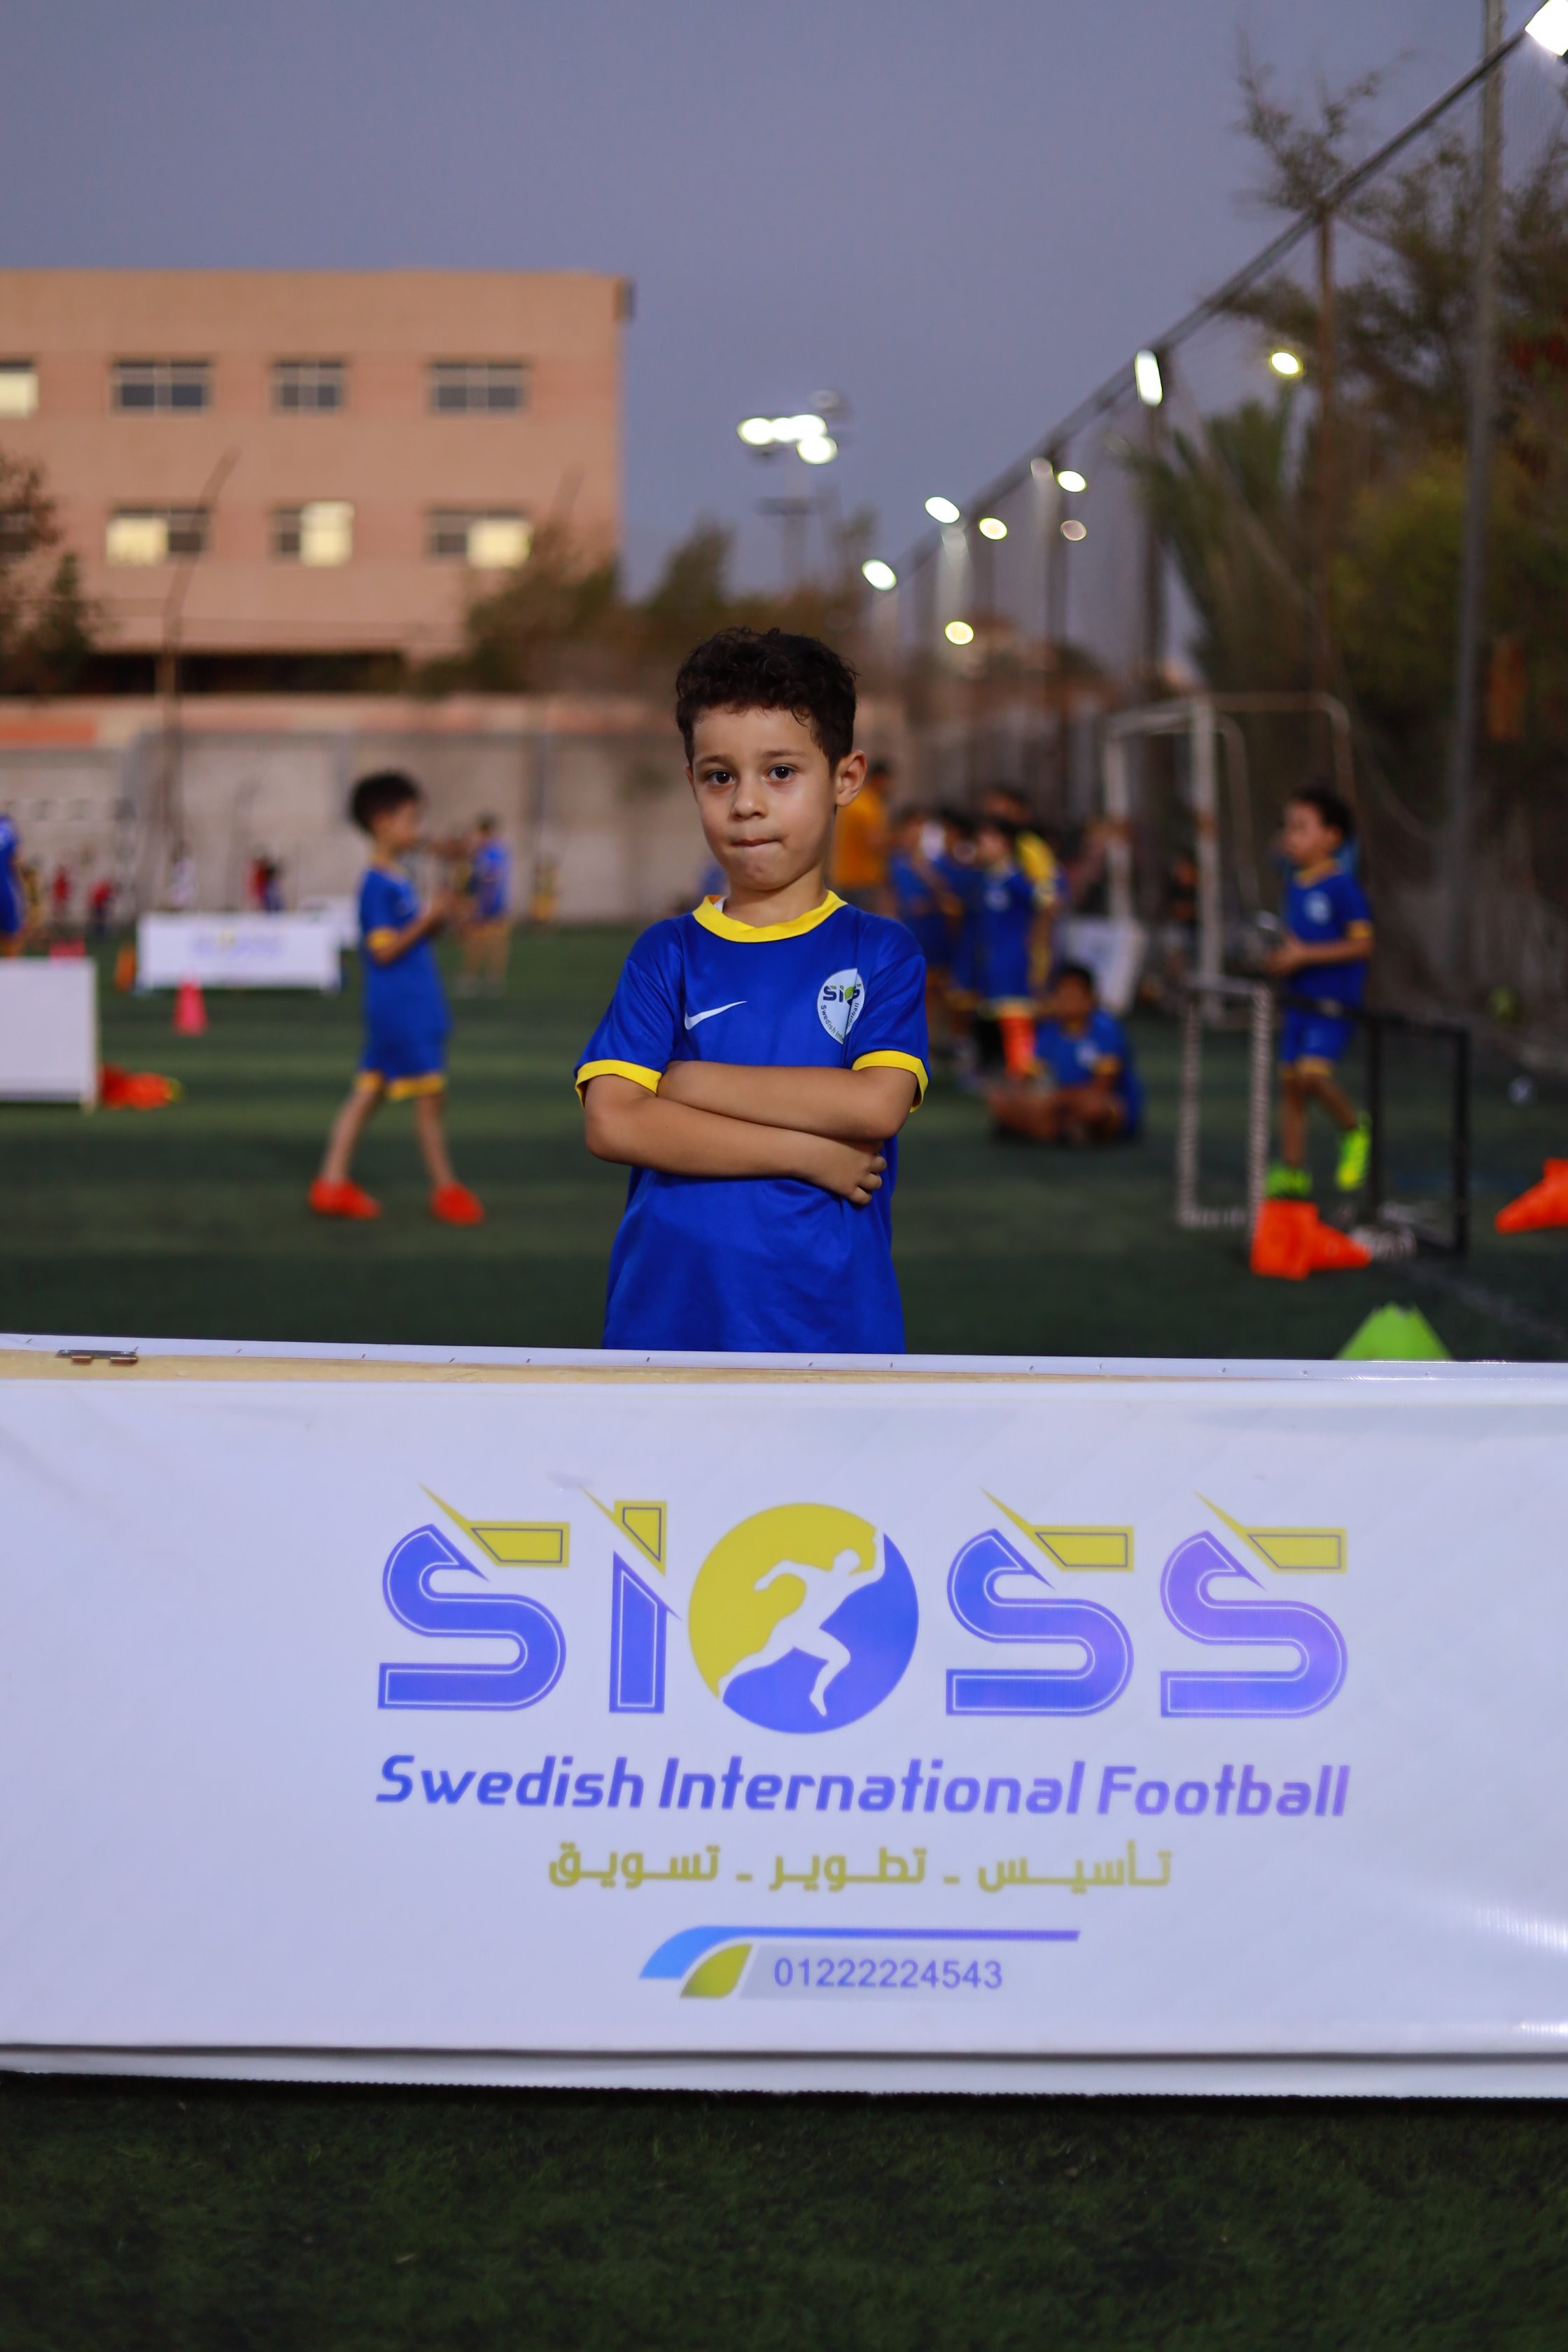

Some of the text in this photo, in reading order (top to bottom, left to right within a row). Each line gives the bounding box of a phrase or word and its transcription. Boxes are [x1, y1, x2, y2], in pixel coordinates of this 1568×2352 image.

[821, 1002, 860, 1033] Swedish ootball
[376, 1754, 1351, 1816] Swedish International Football
[548, 1842, 720, 1889] تسويق
[768, 1846, 927, 1892] تطوير
[774, 1957, 1003, 1989] 01222224543
